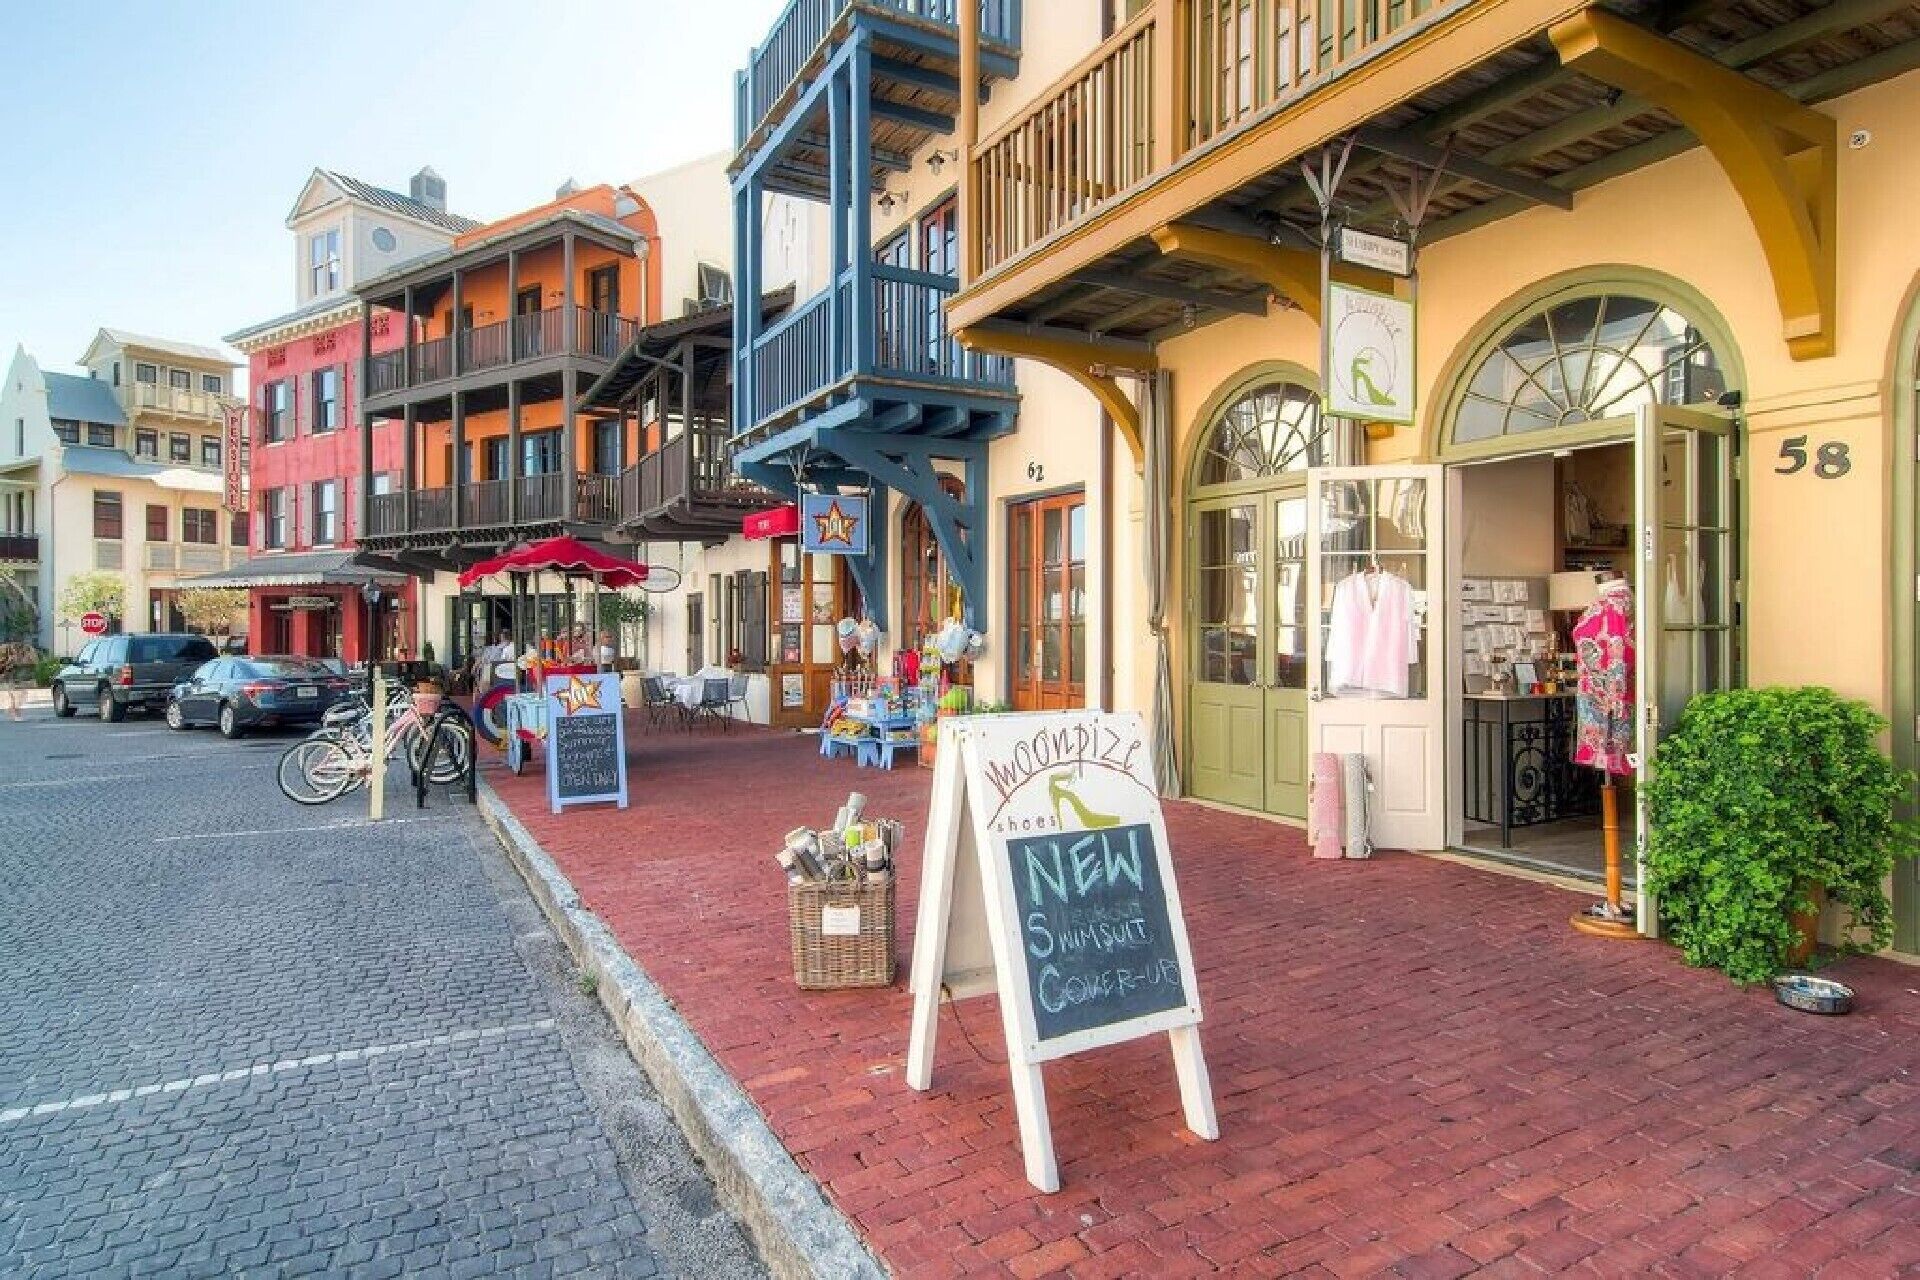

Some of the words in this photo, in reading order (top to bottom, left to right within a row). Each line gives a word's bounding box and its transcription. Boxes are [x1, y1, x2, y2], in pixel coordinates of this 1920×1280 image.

[1774, 434, 1852, 480] 58
[1028, 461, 1044, 482] 62
[82, 618, 104, 628] STOP
[997, 814, 1056, 832] shoes
[1024, 830, 1144, 906] NEW
